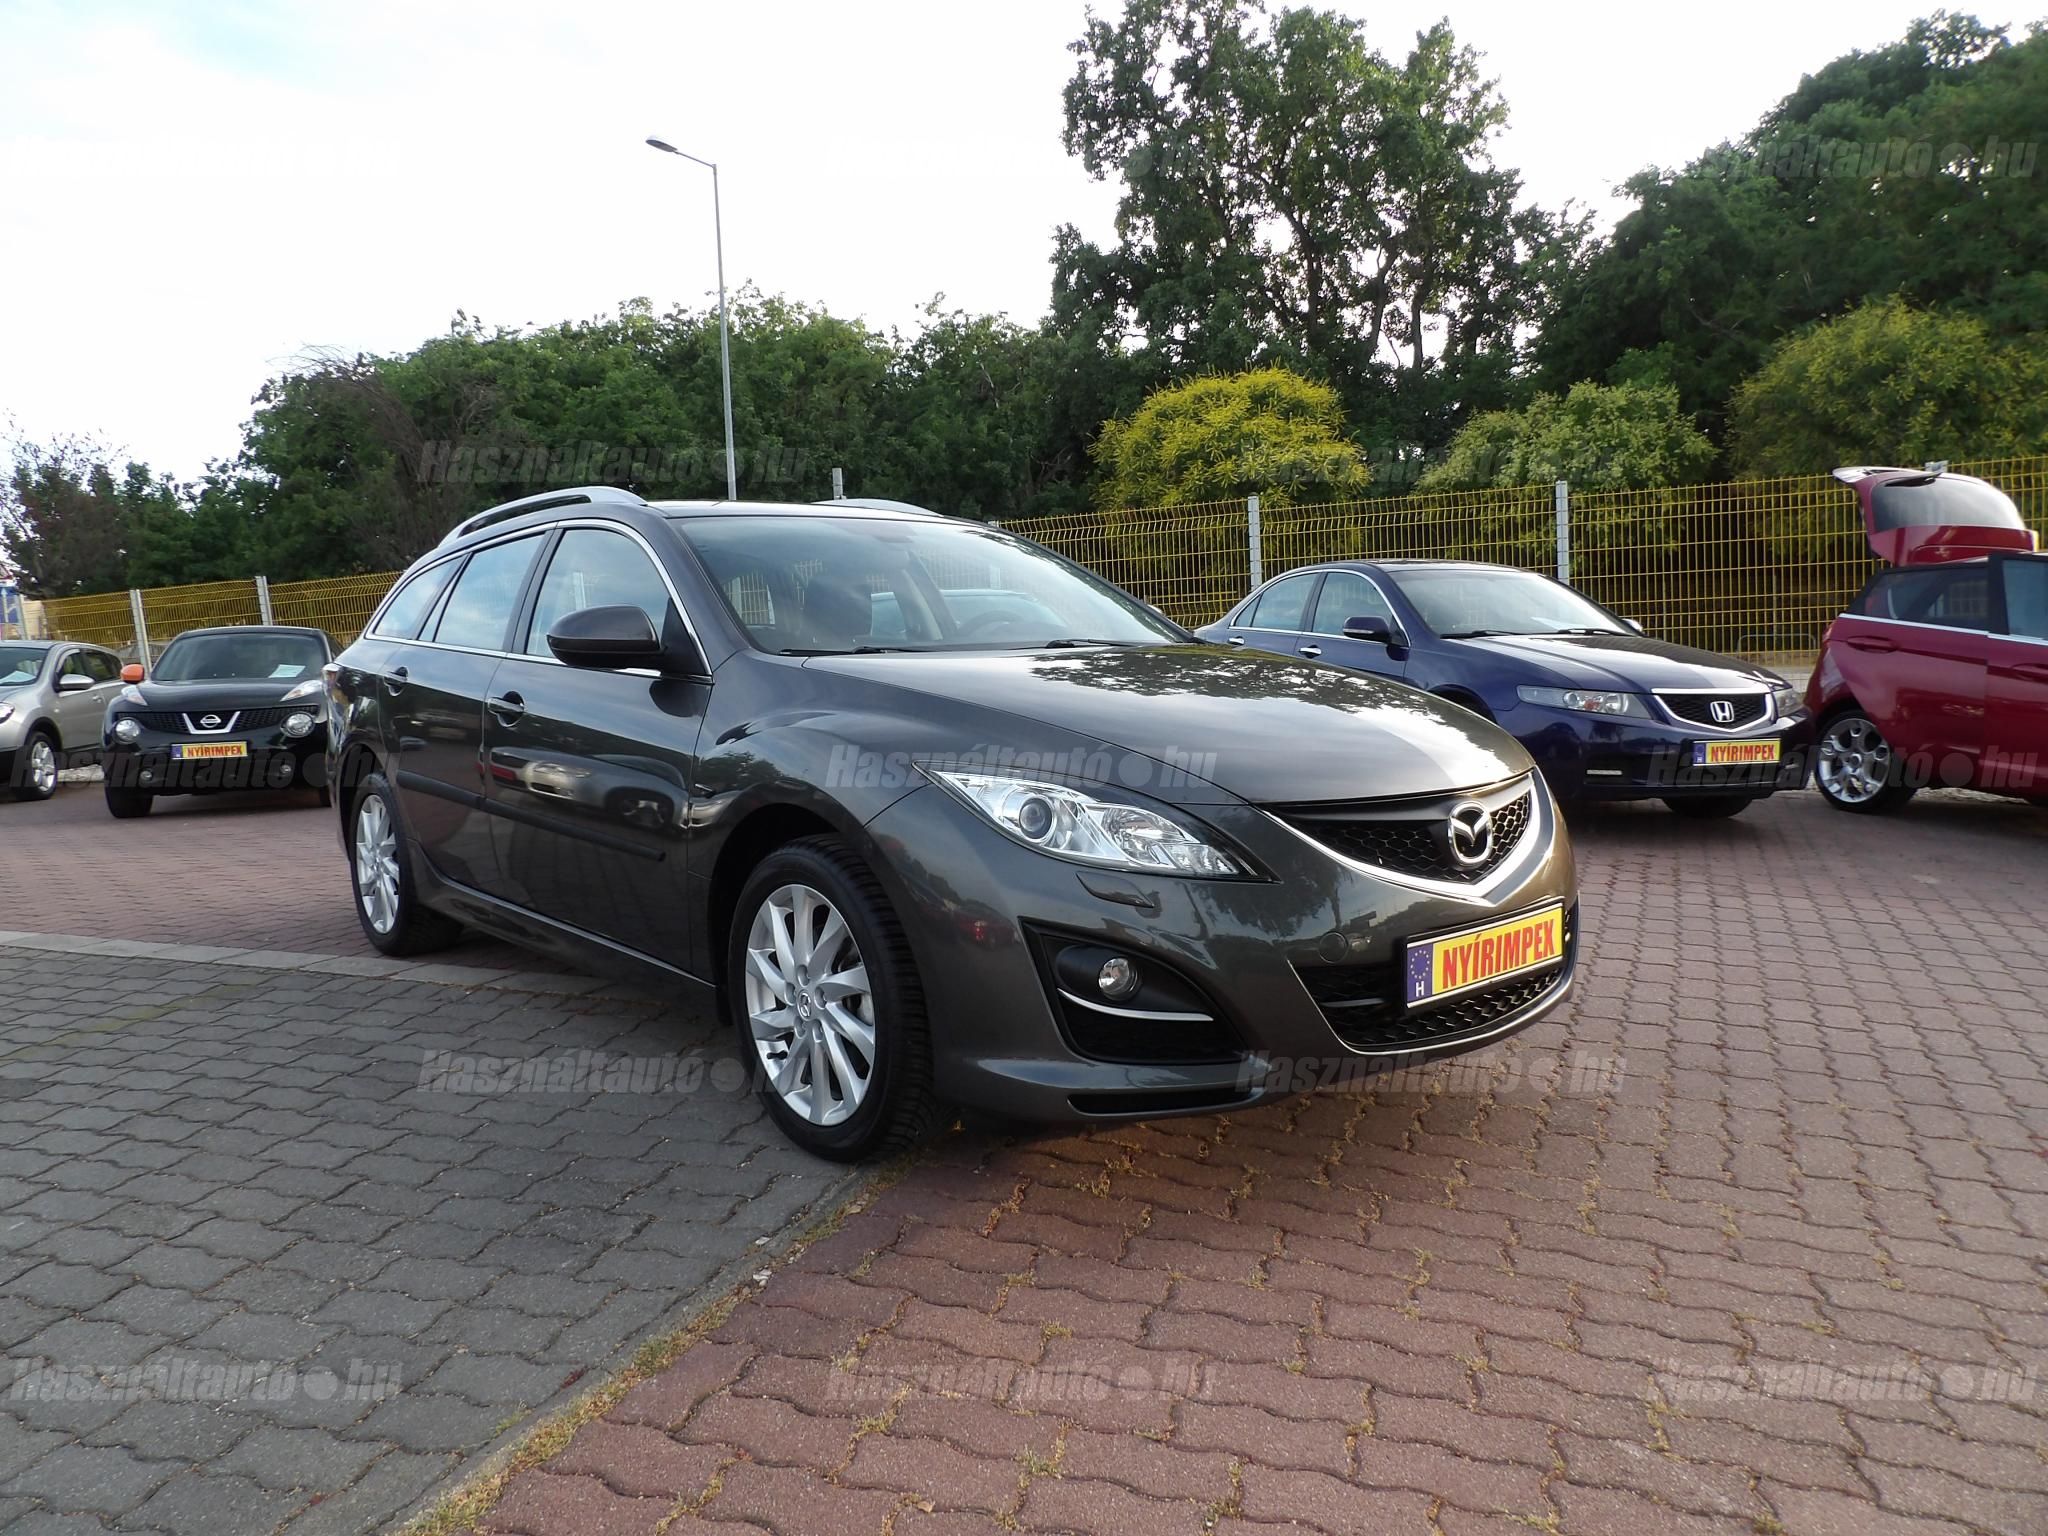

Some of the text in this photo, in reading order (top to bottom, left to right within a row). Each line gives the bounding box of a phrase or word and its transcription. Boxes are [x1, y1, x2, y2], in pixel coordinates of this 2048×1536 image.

[1711, 743, 1775, 761] NYÍRIMPEX
[1415, 919, 1555, 997] H NYÍRIMPEX
